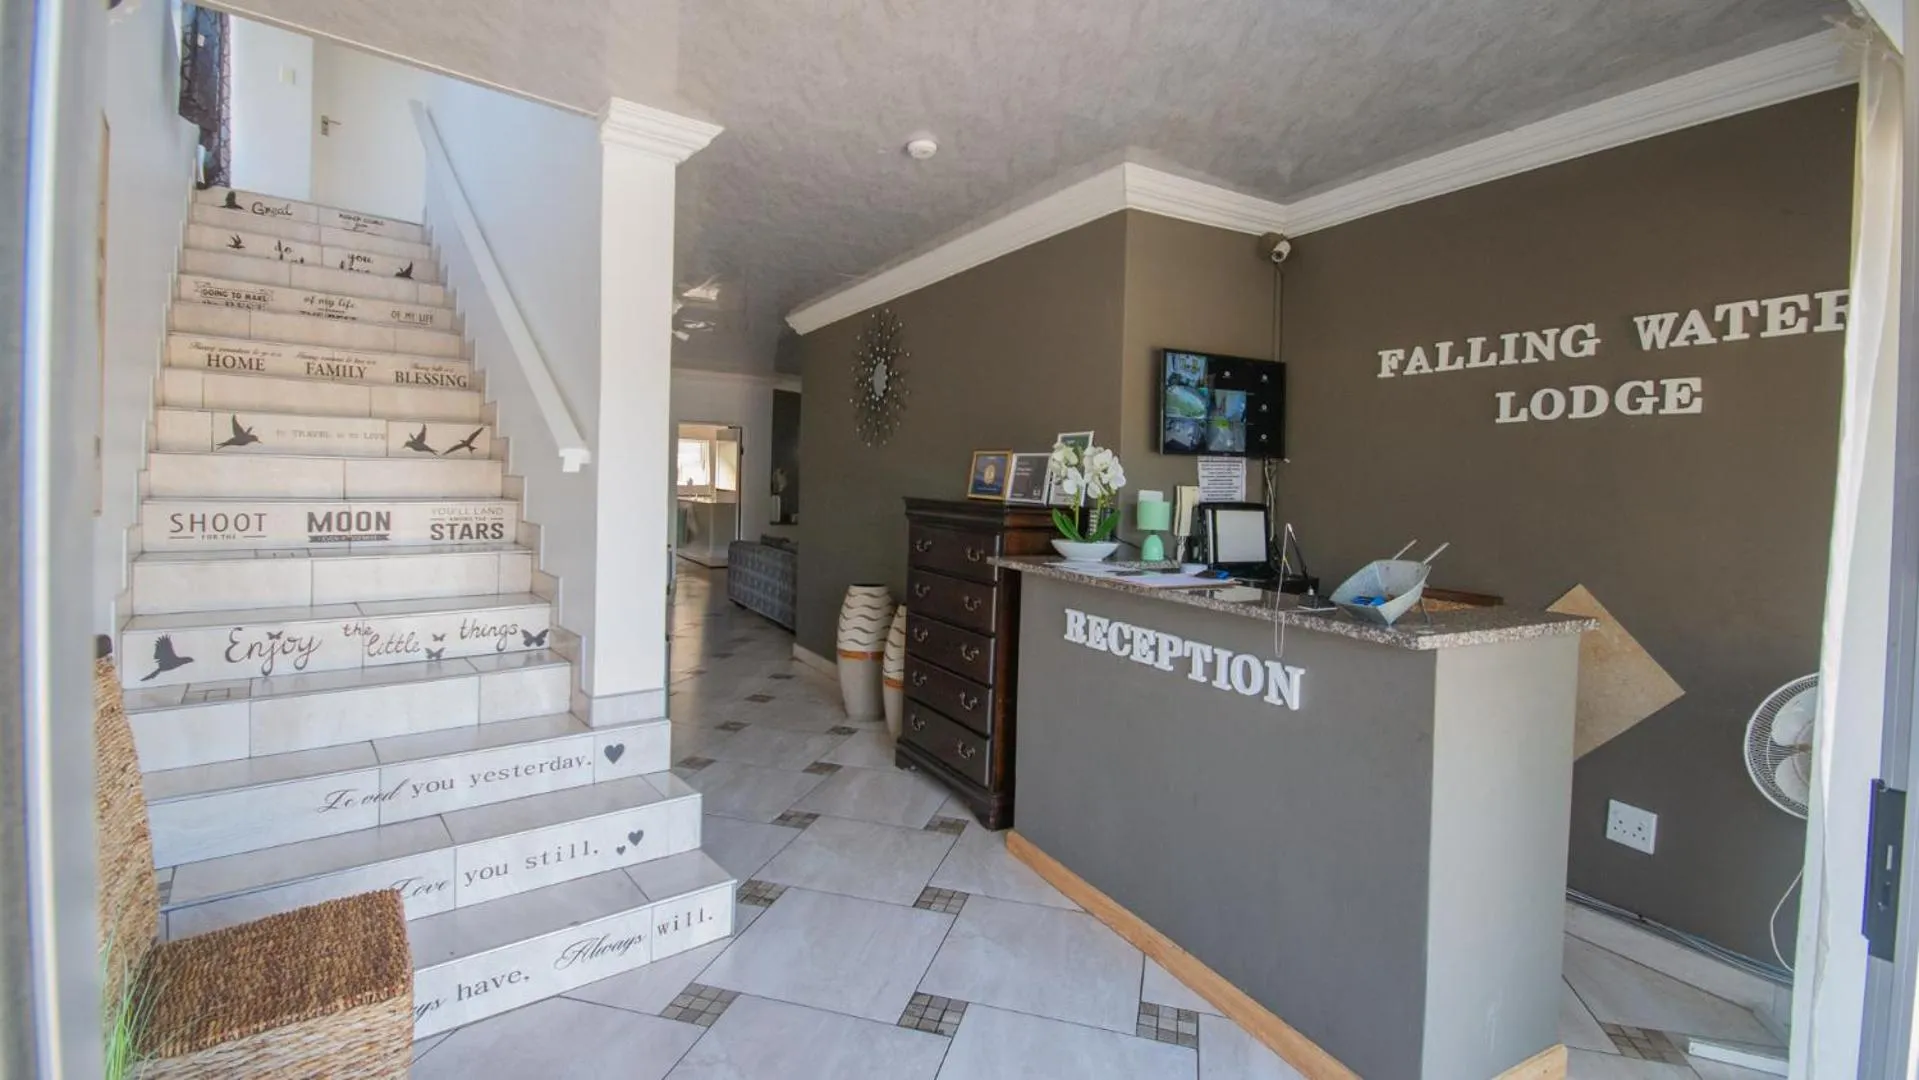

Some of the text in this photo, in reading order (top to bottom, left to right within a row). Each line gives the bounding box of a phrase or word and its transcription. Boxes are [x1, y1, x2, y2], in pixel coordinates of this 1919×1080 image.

[207, 353, 266, 371] HOME
[1377, 323, 1601, 378] FALLING
[305, 361, 367, 379] FAMILY
[394, 371, 467, 388] BLESSING
[1495, 376, 1703, 423] LODGE
[170, 513, 267, 533] SHOOT
[307, 511, 391, 533] MOON
[430, 522, 504, 541] STARS
[343, 622, 374, 638] the
[366, 632, 420, 658] little
[459, 618, 518, 652] things
[225, 626, 323, 676] Enjoy
[1064, 608, 1306, 710] RECEPTION
[411, 778, 454, 799] you
[469, 754, 592, 788] yesterday.
[464, 864, 508, 886] you
[526, 840, 598, 870] still.
[457, 906, 714, 1003] have. Always will.
